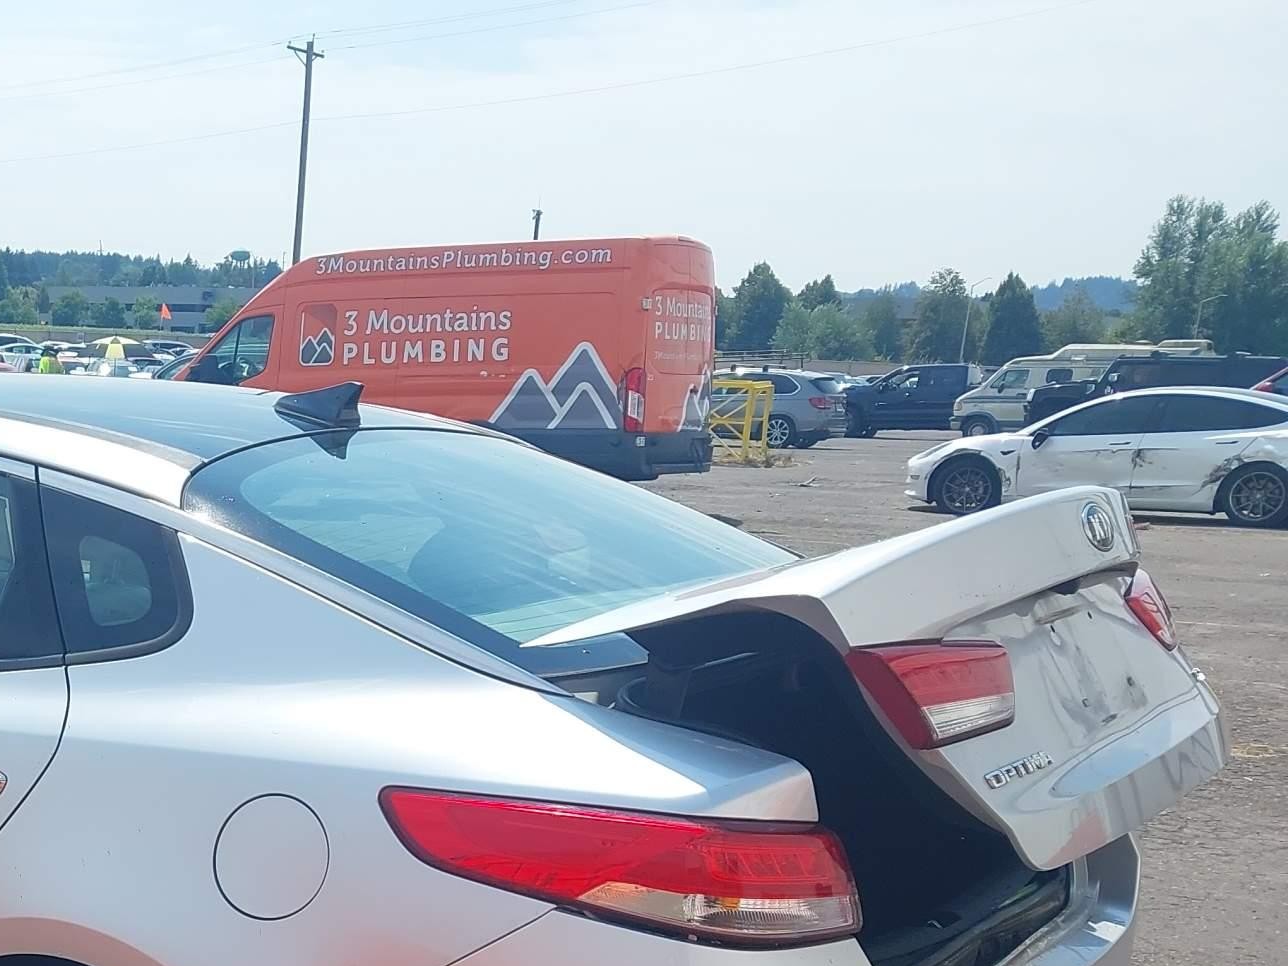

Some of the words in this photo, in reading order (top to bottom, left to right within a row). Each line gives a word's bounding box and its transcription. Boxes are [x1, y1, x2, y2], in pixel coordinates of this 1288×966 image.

[316, 248, 612, 275] 3MountainsPlumbing.com
[655, 295, 663, 316] 3
[343, 310, 358, 336] 3
[365, 306, 512, 335] Mountains
[342, 337, 510, 365] PLUMBING
[984, 751, 1053, 789] OPTIMA
